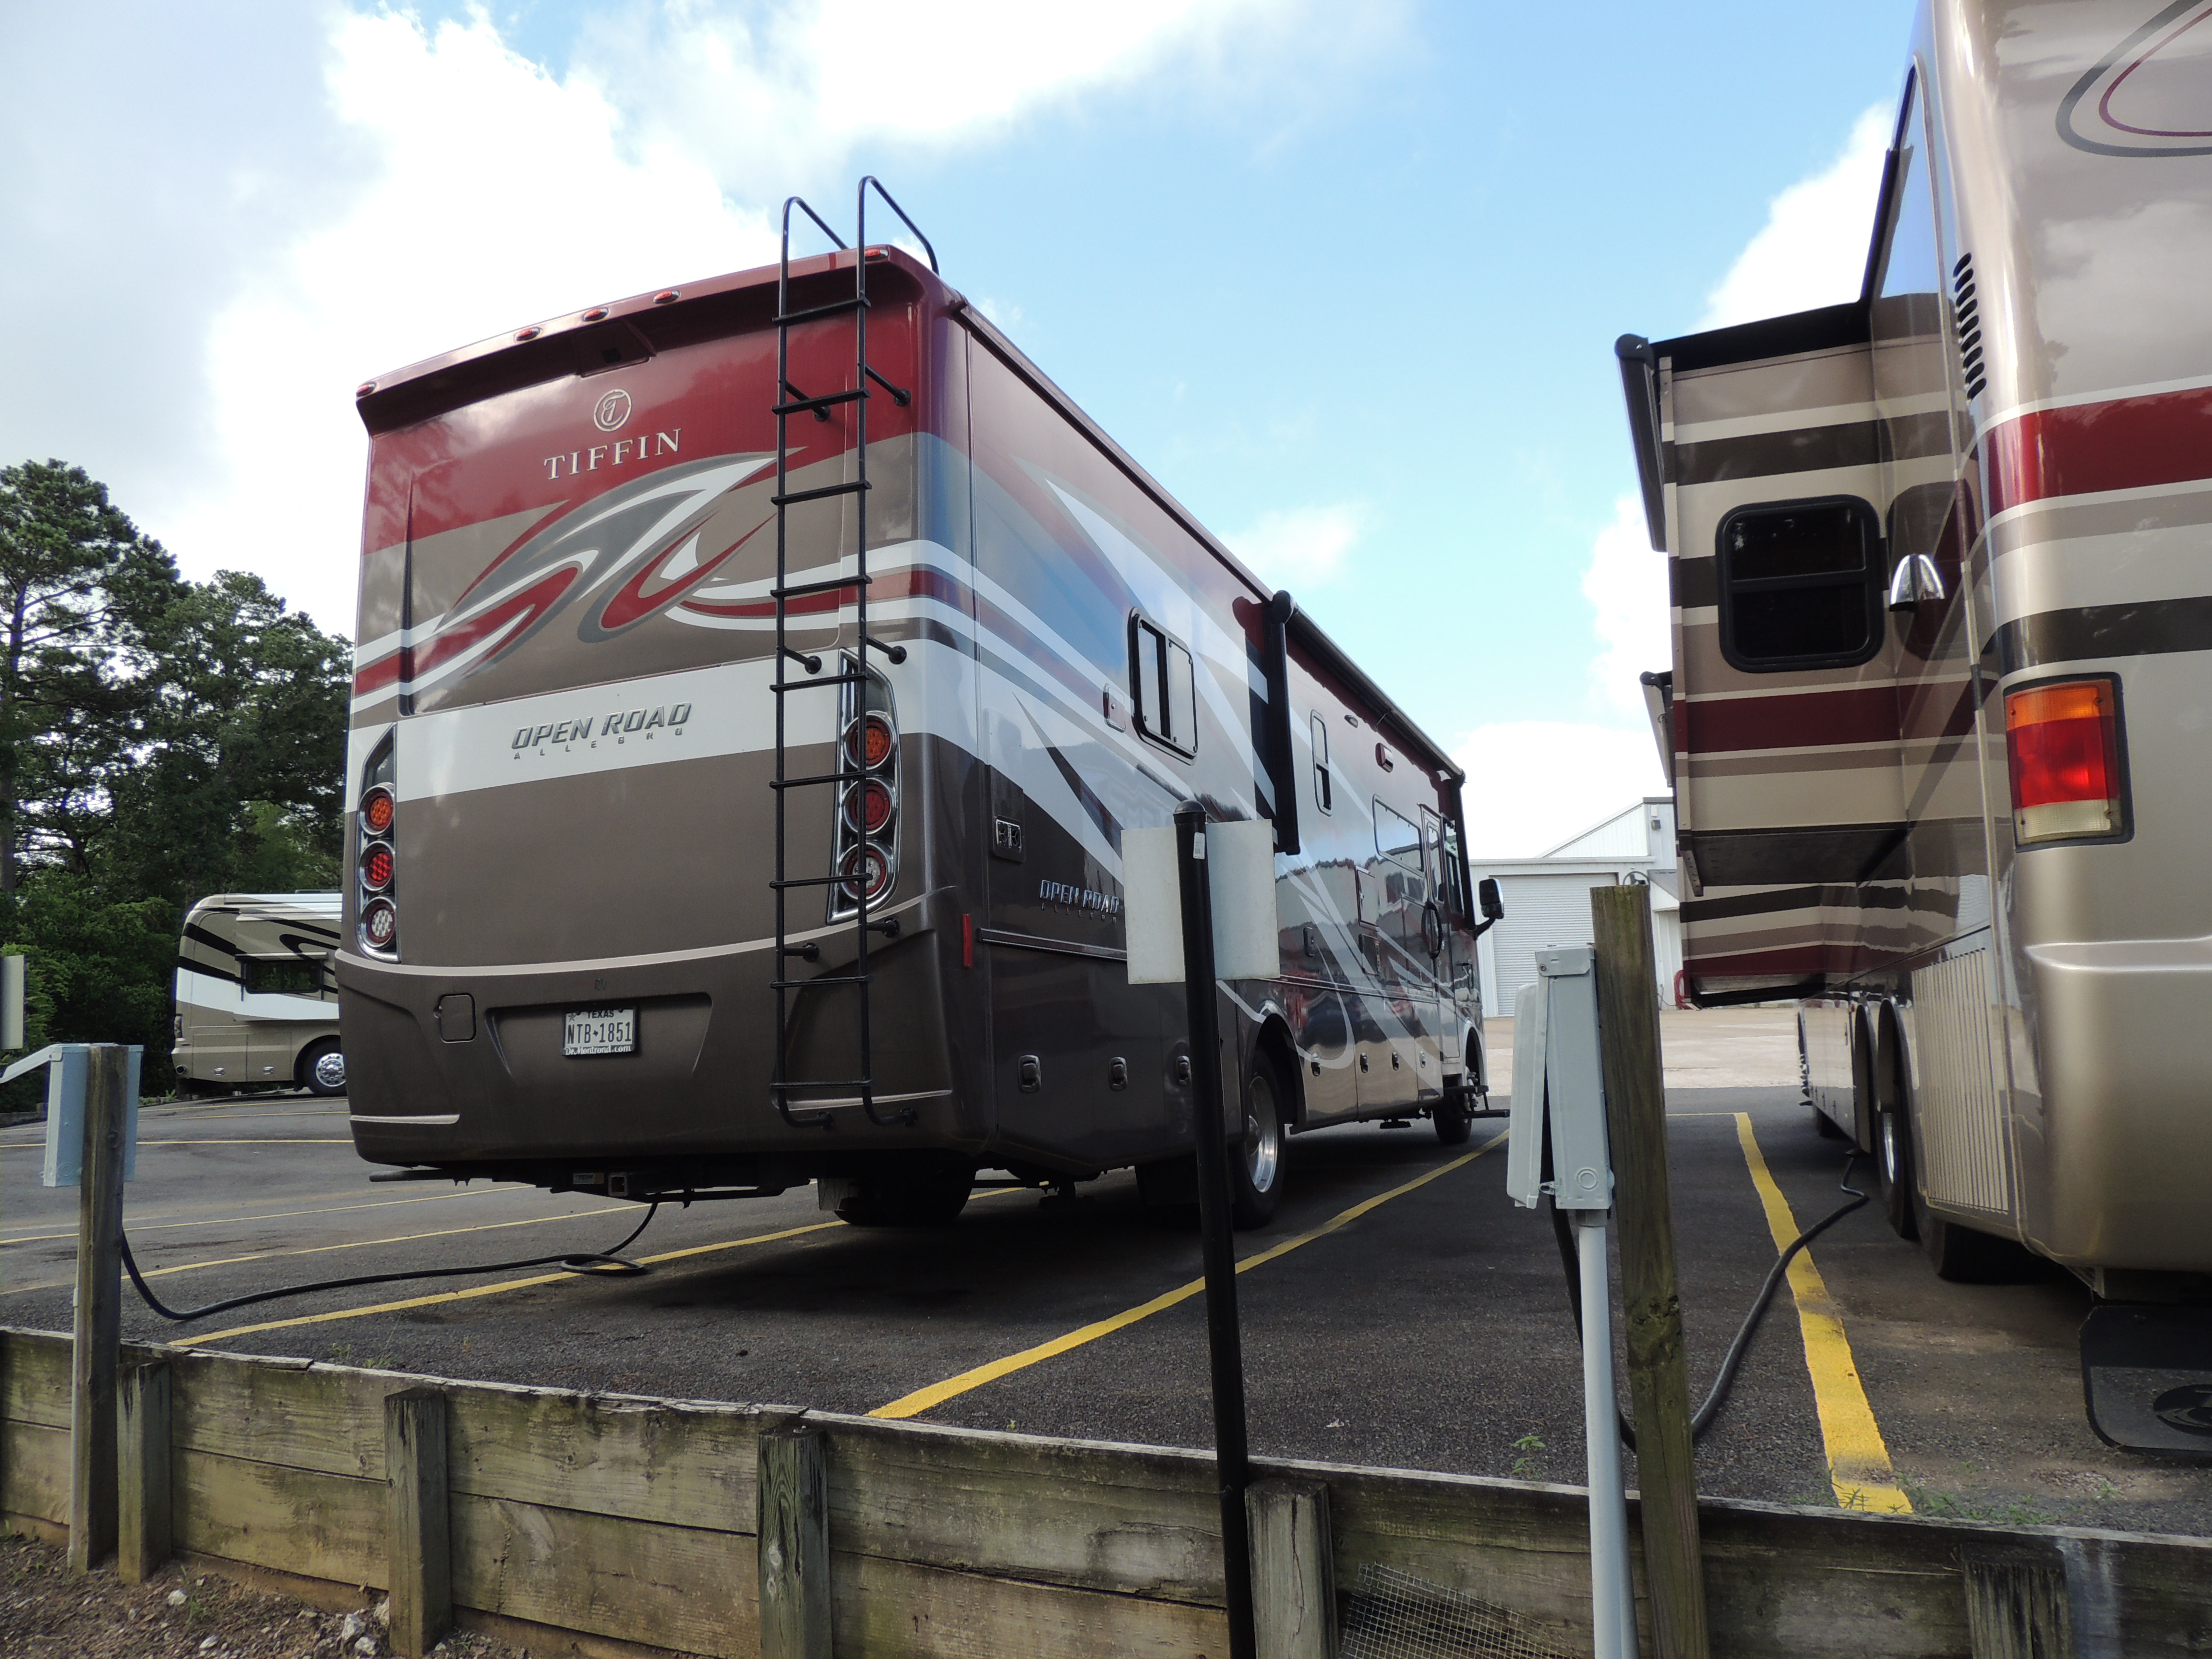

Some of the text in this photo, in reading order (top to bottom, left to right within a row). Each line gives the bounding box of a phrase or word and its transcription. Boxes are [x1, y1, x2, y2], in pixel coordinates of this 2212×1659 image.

[544, 428, 681, 480] TIFFIN
[511, 702, 692, 750] OPEN ROAD
[514, 727, 683, 760] ALLEGRO
[1039, 879, 1119, 914] OPEN ROAD
[587, 1010, 614, 1019] TEXAS
